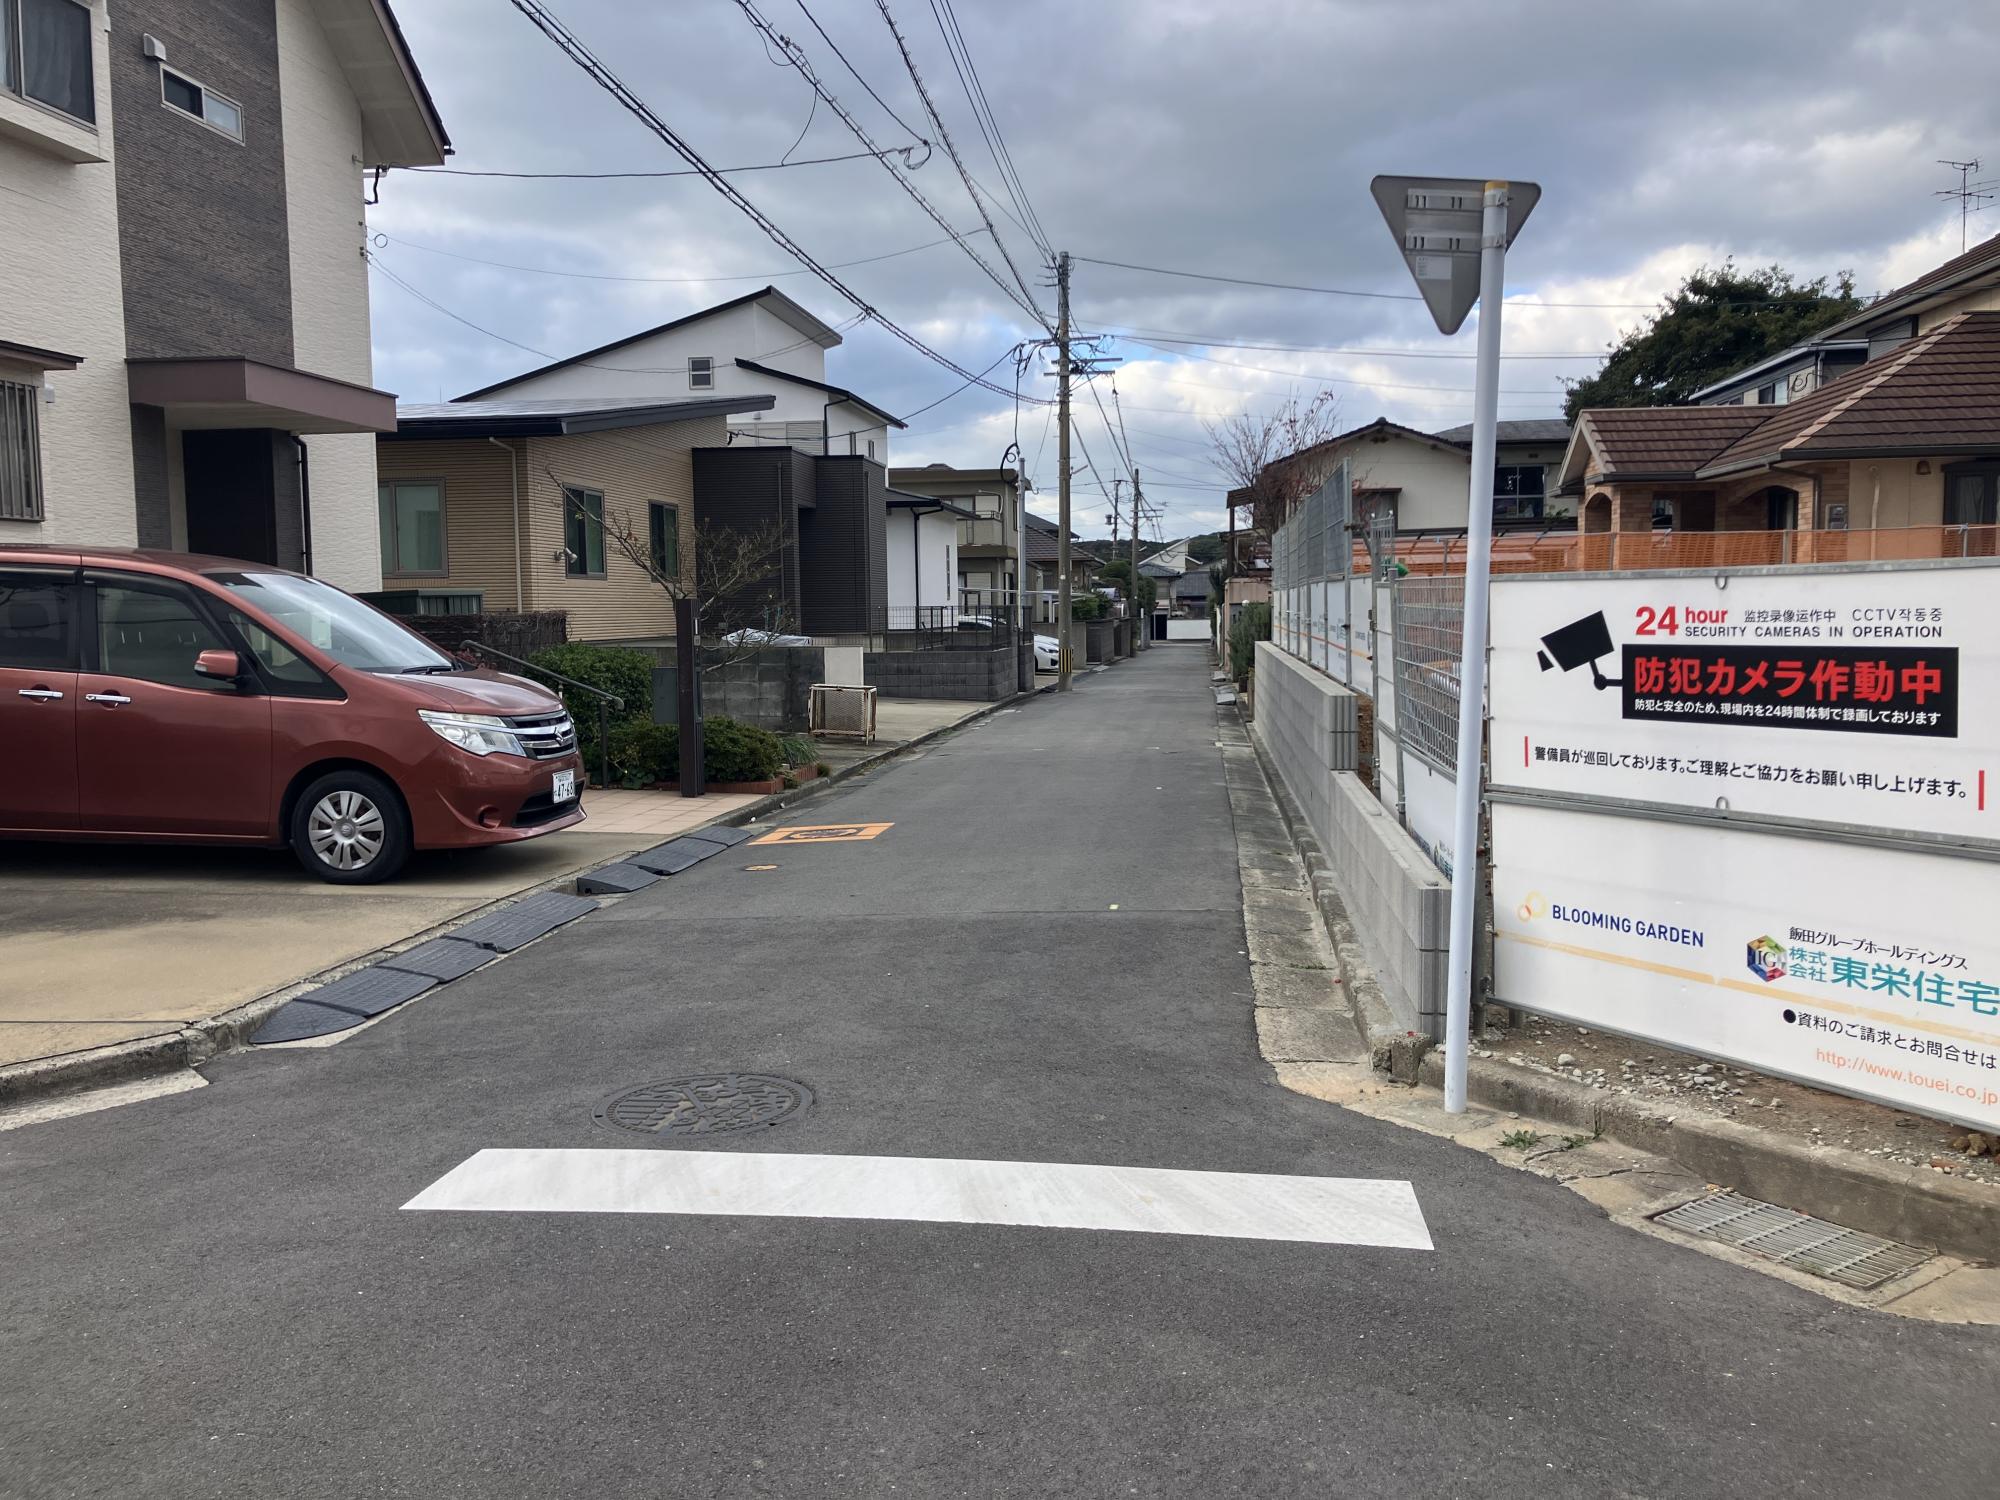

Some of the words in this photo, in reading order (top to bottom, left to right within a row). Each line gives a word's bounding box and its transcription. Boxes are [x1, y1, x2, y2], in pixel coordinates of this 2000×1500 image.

[1636, 606, 1679, 636] 24
[1685, 606, 1728, 624] hour
[1685, 626, 1746, 638] SECURITY
[1754, 626, 1820, 638] CAMERAS
[1829, 626, 1843, 638] IN
[1852, 626, 1943, 638] OPERATION
[1744, 609, 1837, 624] 监控录像运作中
[1634, 656, 1942, 705] 防犯カメラ作動中
[1634, 699, 1942, 726] 防犯と安全のため、現場内を24時間体制で録画しております
[1535, 746, 1967, 799] 警備員が巡回しております。ご理解とご協力をお願い申し上げます。
[1552, 904, 1631, 933] BLOOMING
[1635, 920, 1704, 947] GARDEN
[1789, 926, 1968, 970] 飯田グループホールディングス
[1830, 956, 2000, 1016] 東栄住宅
[1816, 1048, 1998, 1106] http://www.touei.co.jp
